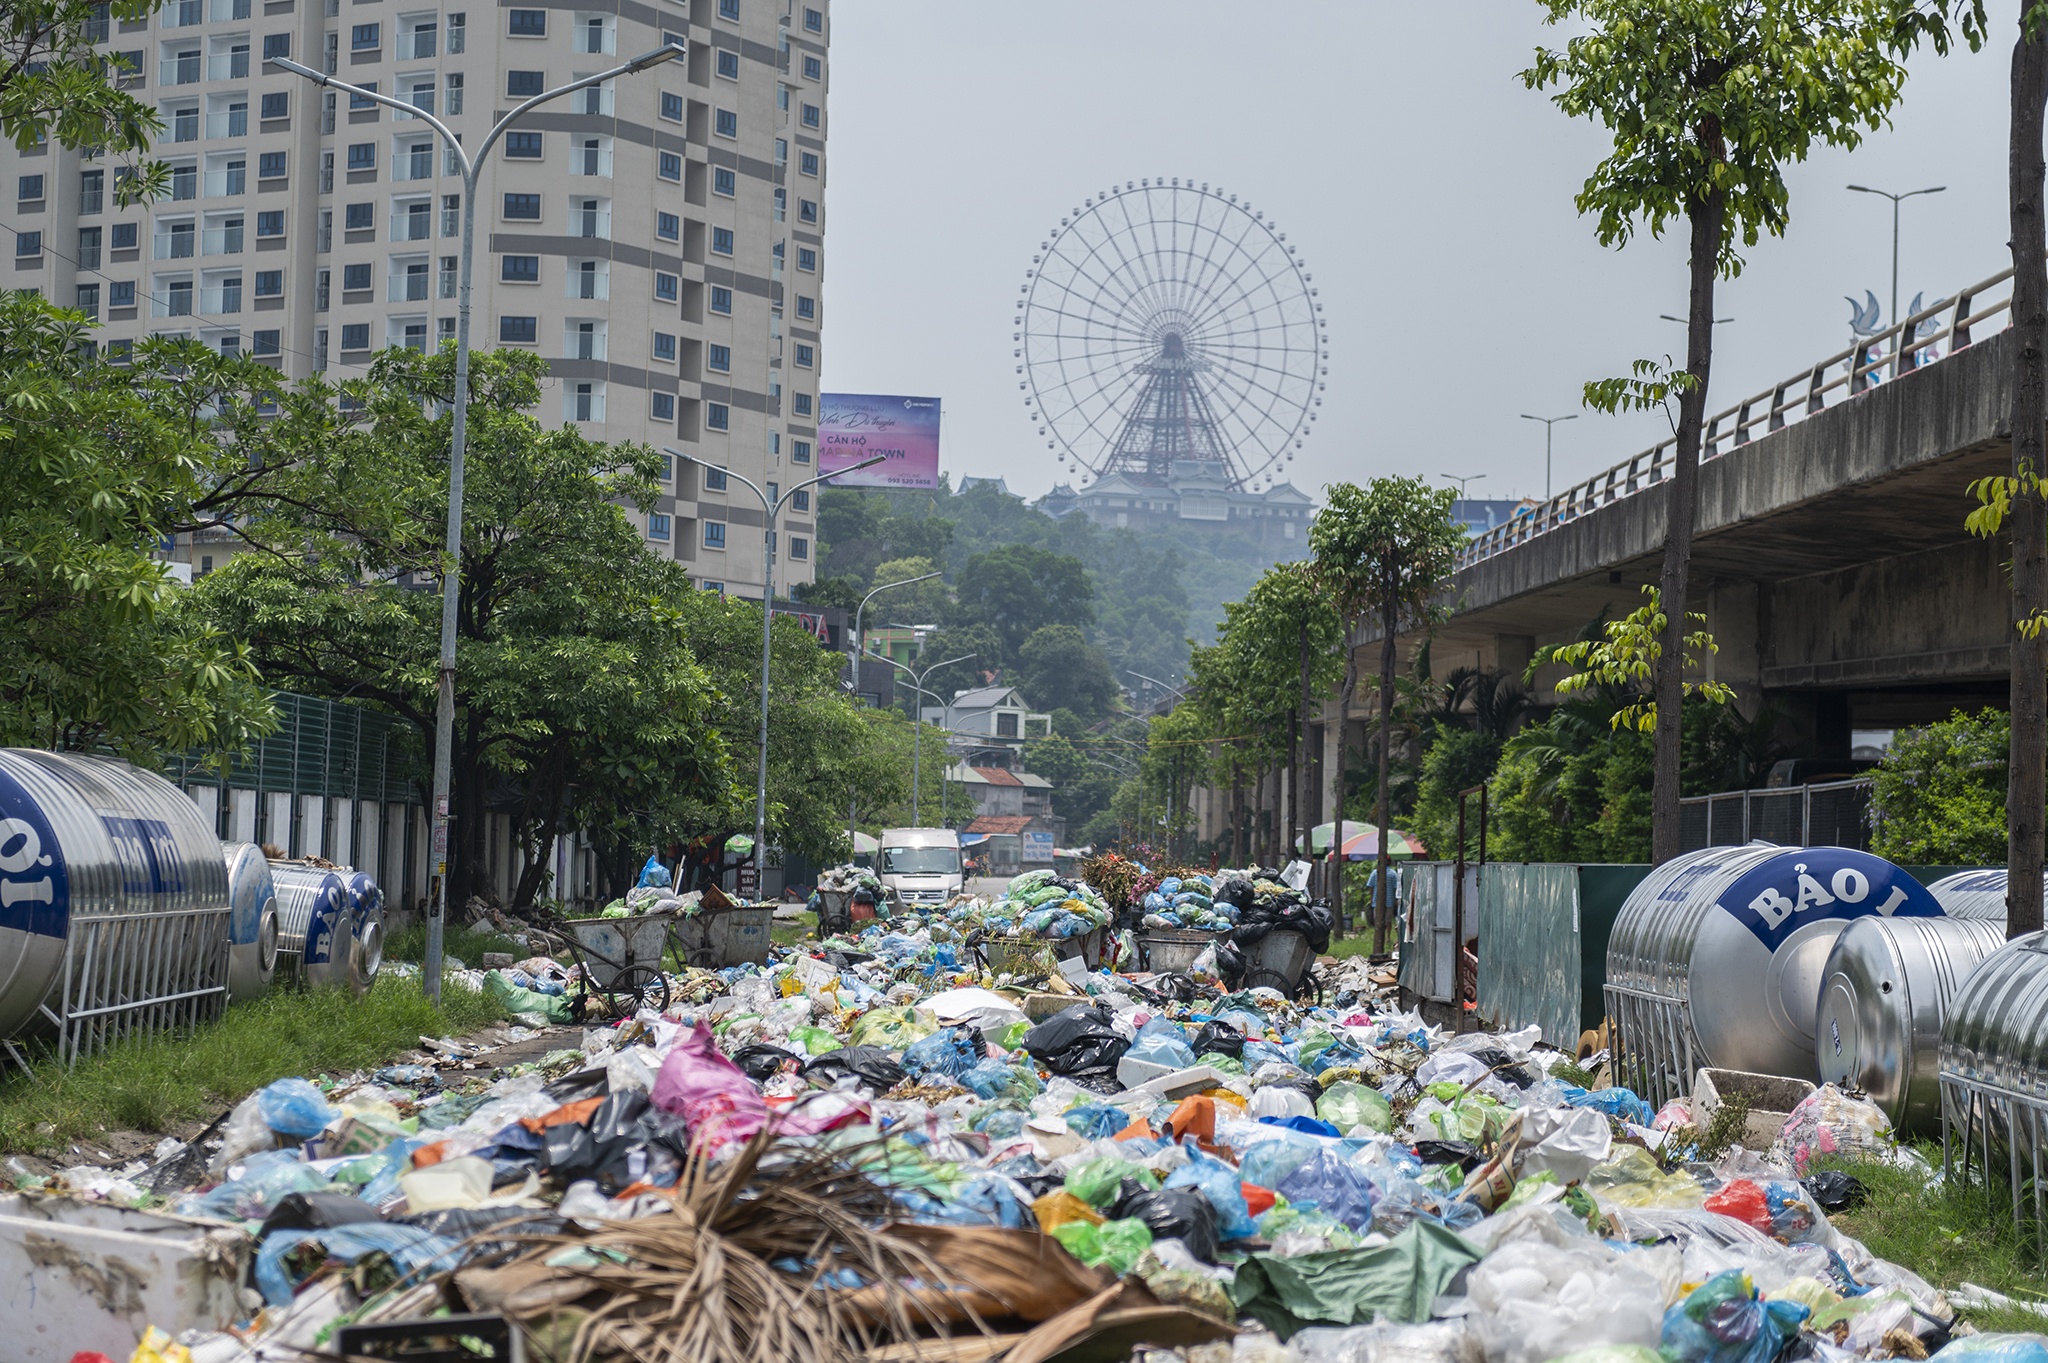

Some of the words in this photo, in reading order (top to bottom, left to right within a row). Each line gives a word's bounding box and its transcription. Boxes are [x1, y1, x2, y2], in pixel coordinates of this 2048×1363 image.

[827, 435, 849, 445] CĂN
[852, 436, 866, 447] HỘ
[867, 449, 905, 459] TOWN
[1748, 863, 1870, 931] BẢO
